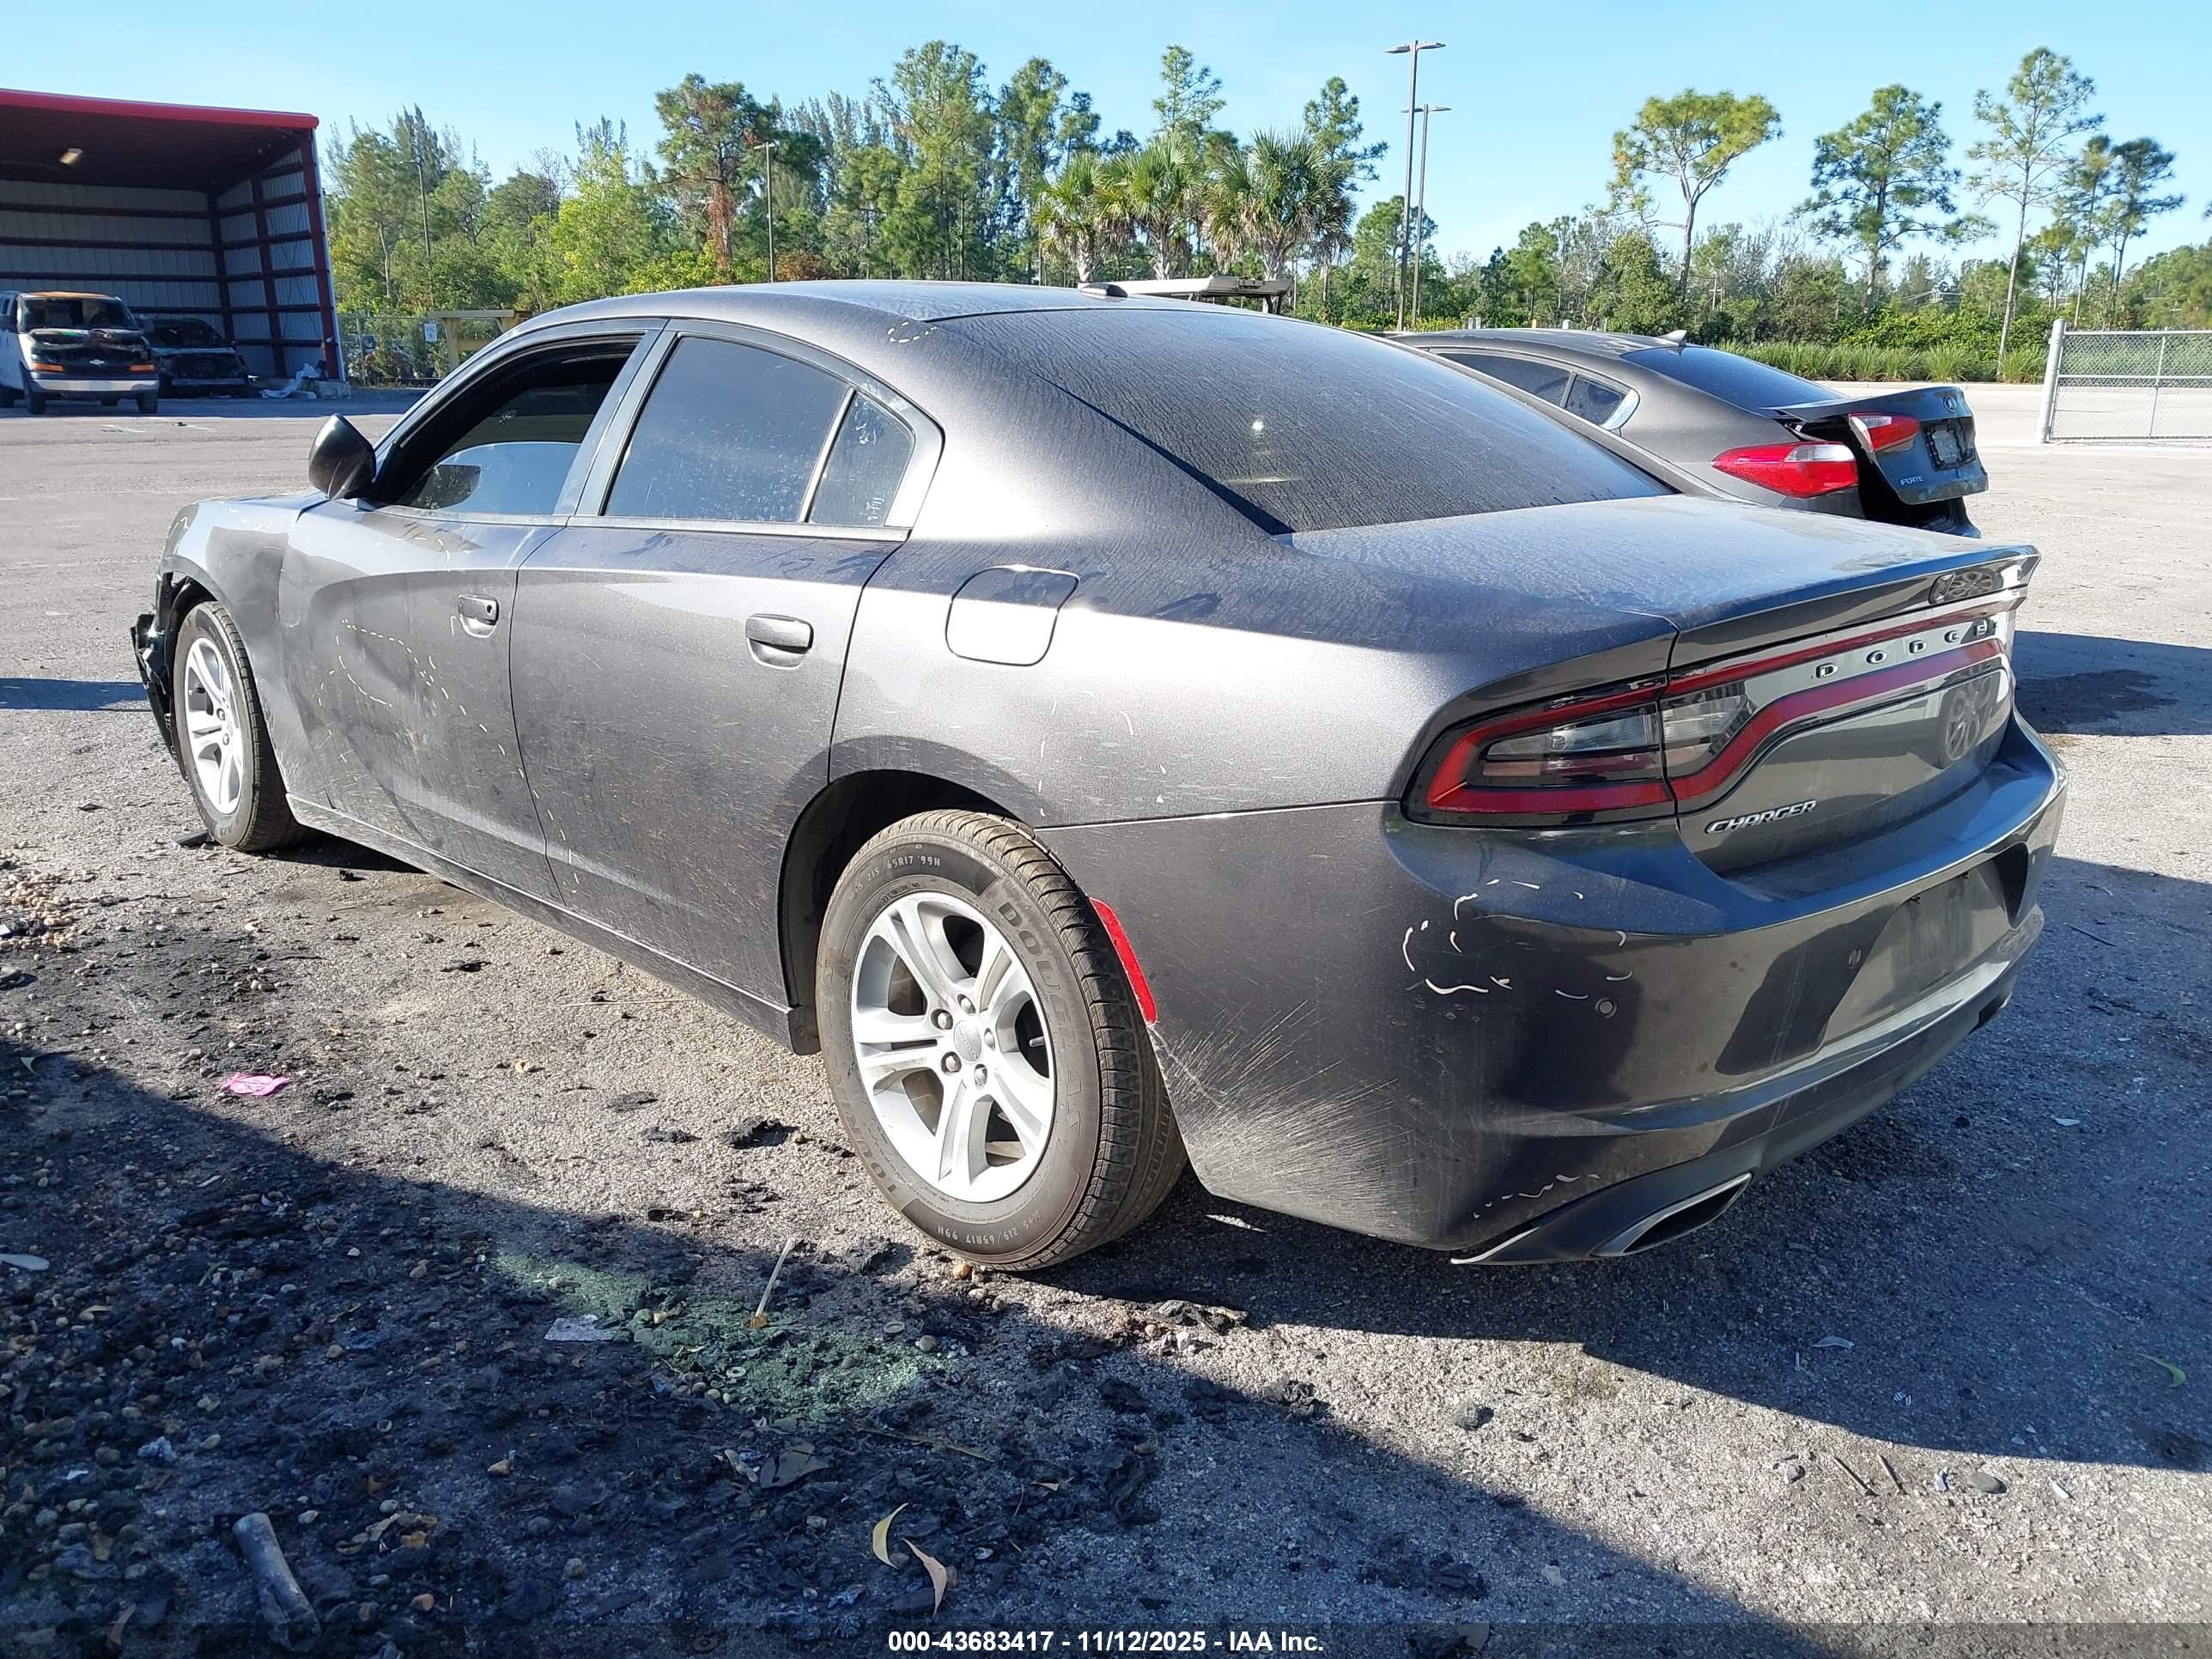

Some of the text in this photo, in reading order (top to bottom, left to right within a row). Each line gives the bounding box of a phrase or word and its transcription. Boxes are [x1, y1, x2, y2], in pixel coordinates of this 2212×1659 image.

[1815, 617, 1992, 678] DODGE
[1705, 799, 1817, 834] CHARGER
[938, 1225, 958, 1241] 99H
